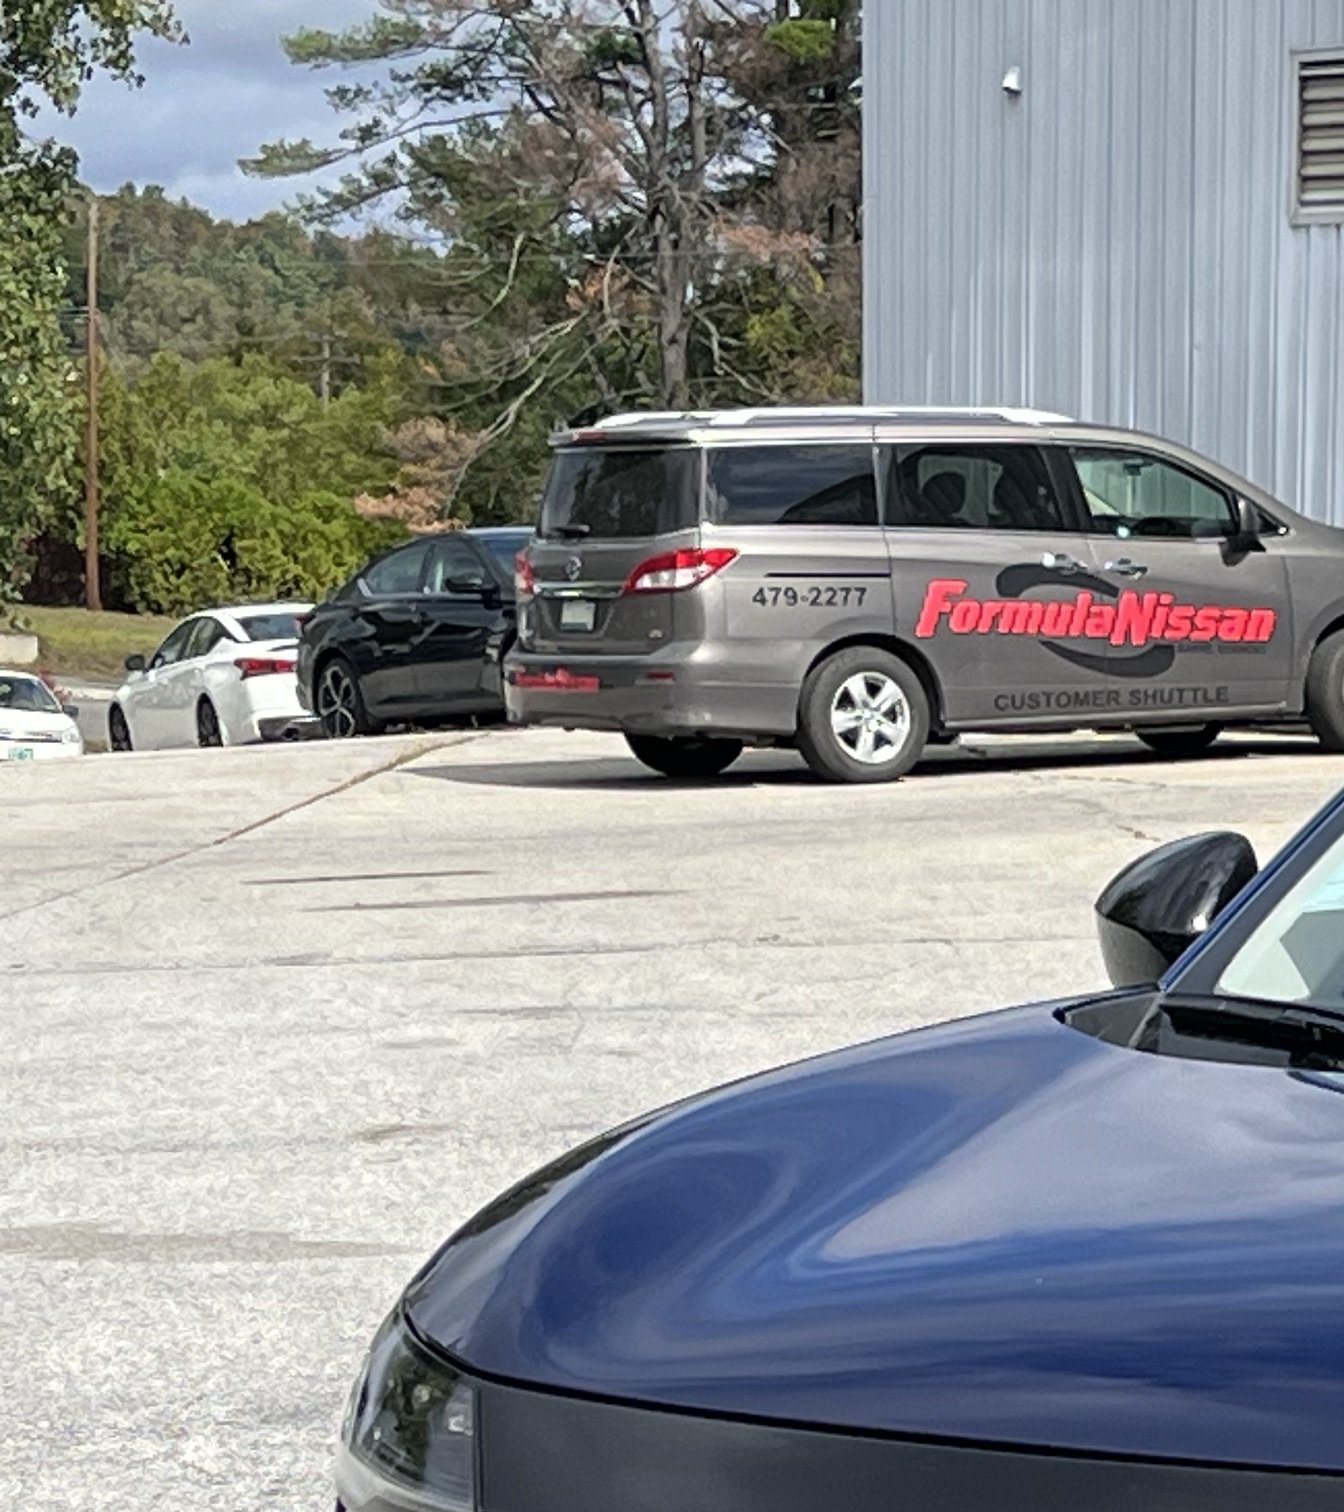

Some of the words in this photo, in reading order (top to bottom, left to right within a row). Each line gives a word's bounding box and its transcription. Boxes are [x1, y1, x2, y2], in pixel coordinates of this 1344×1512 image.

[752, 587, 867, 606] 479-2277
[994, 689, 1121, 712] CUSTOMER
[1129, 686, 1231, 707] SHUTTLE
